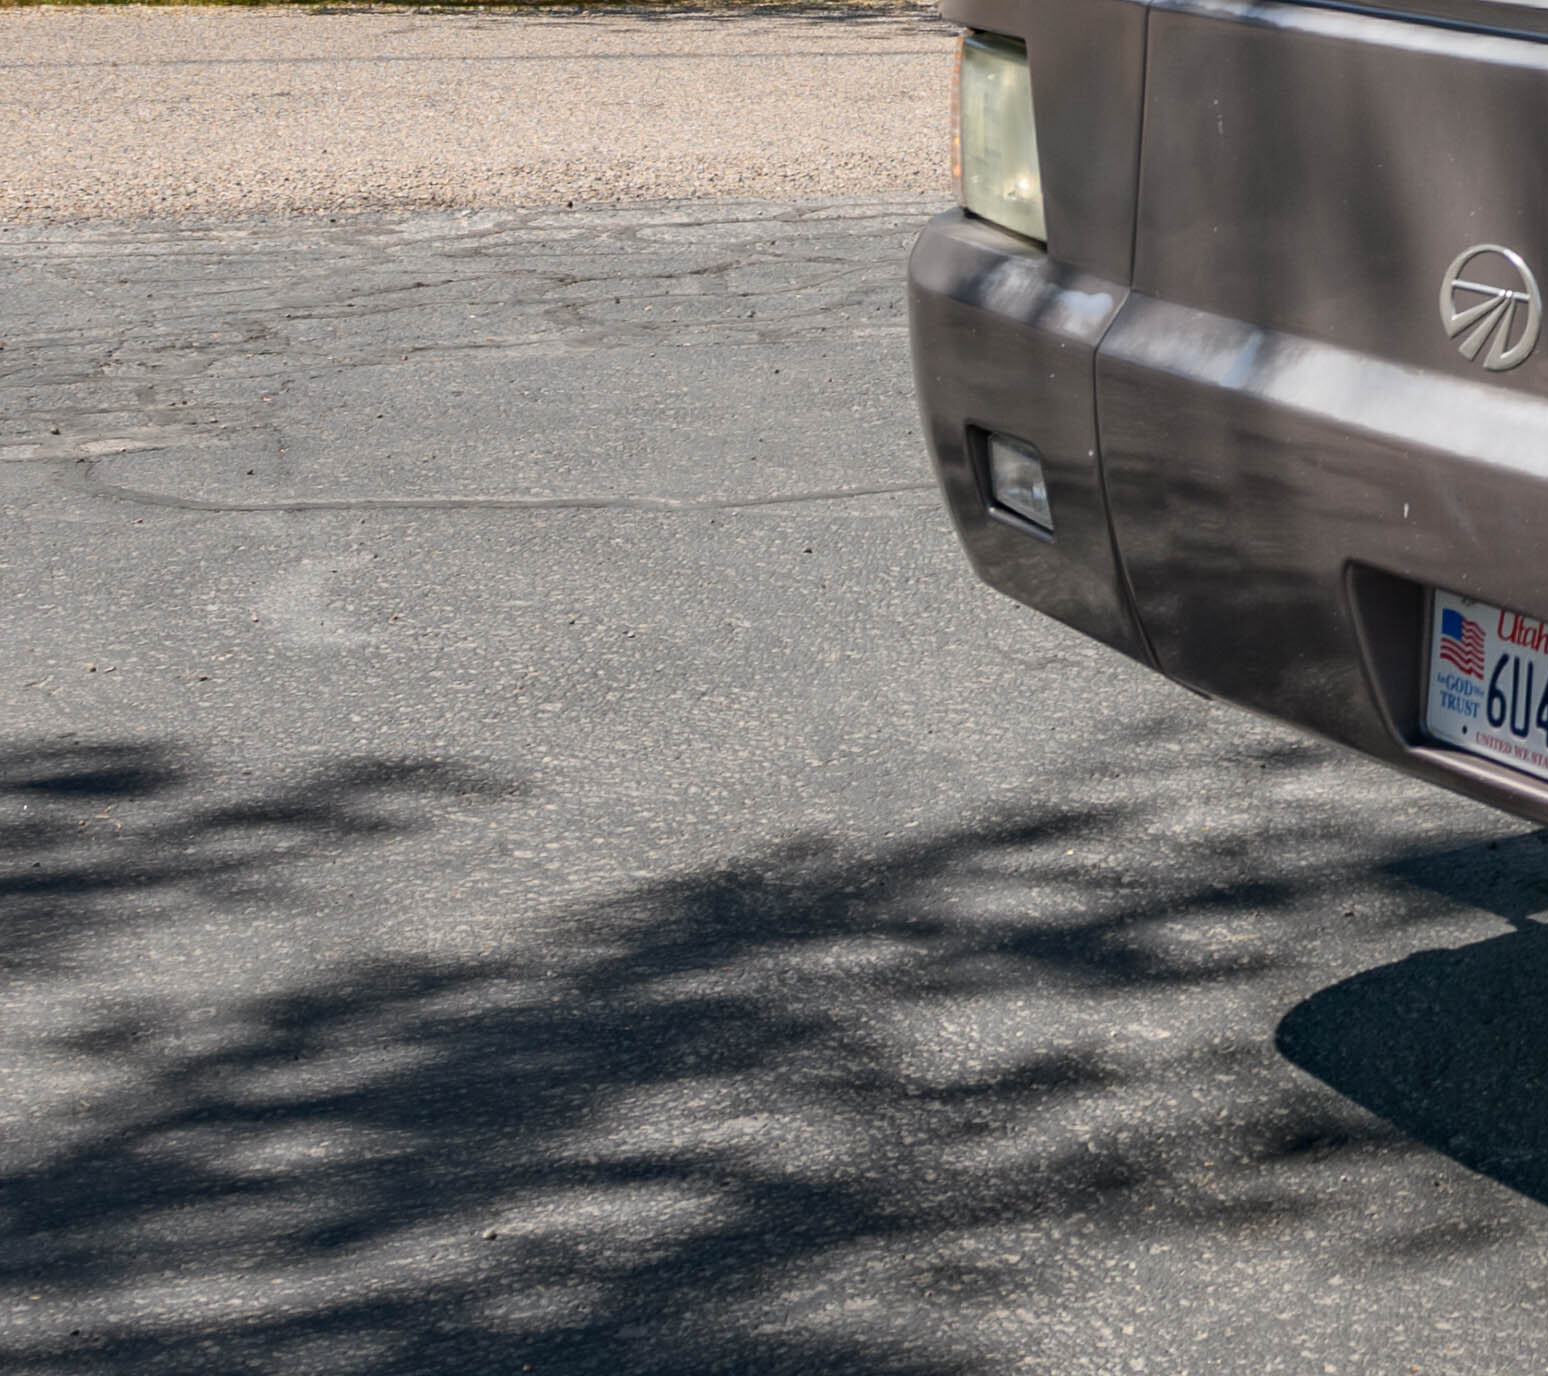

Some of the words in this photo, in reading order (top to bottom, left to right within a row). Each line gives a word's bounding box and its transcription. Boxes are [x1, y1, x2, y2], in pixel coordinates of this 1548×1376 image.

[1446, 674, 1473, 696] GOD
[1439, 690, 1480, 719] TRUST
[1475, 731, 1512, 754] UNITED
[1514, 744, 1529, 761] WE
